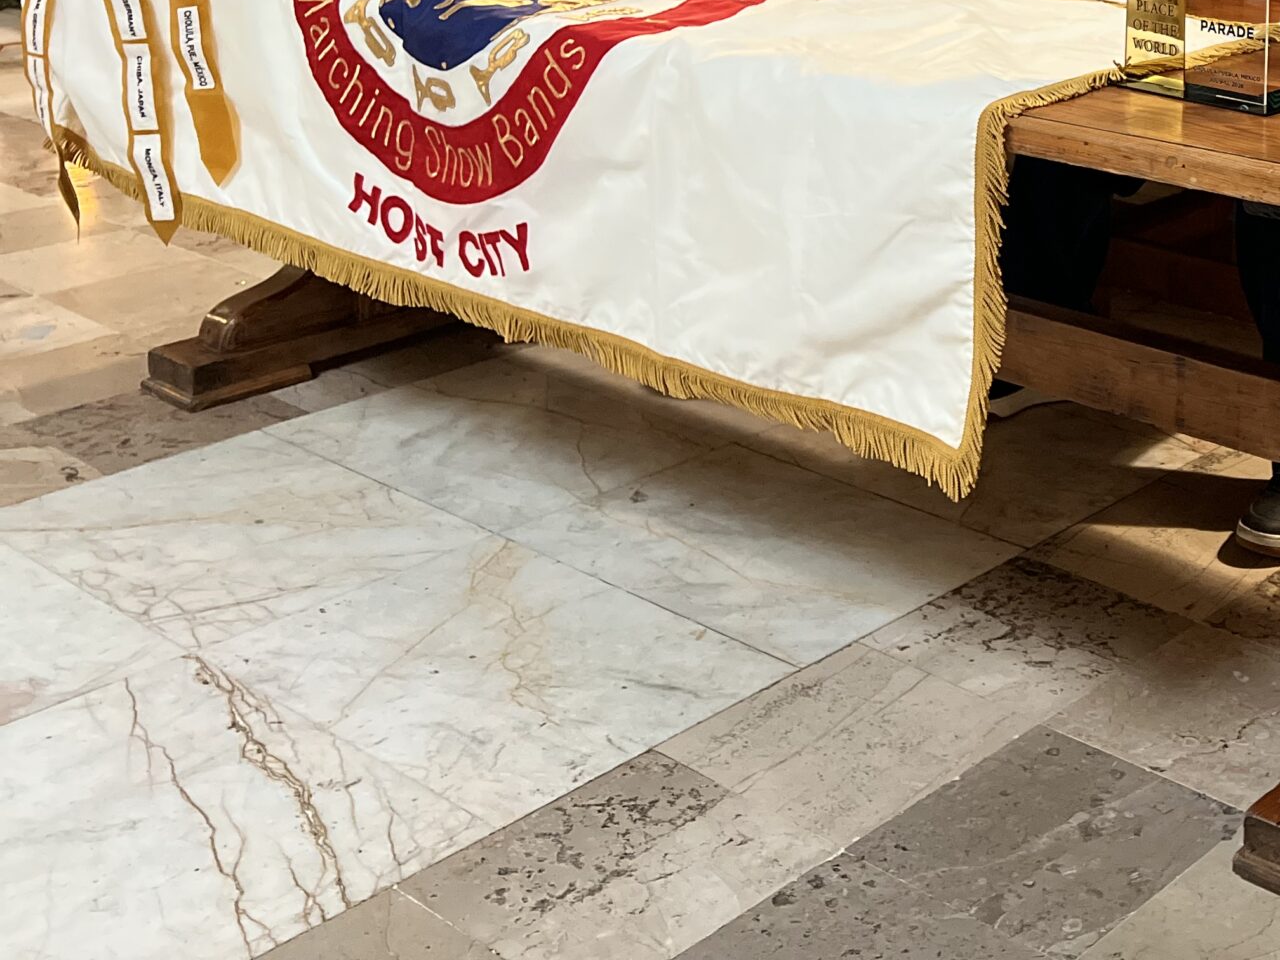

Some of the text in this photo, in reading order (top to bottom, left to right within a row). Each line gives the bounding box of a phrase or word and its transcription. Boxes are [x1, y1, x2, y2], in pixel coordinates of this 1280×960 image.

[1133, 18, 1179, 37] OF THE
[1136, 0, 1175, 17] PLACE
[1132, 37, 1178, 56] WORLD
[1200, 20, 1254, 39] PARADE
[136, 55, 147, 118] CHIBA, JAPAN
[424, 125, 493, 188] Show
[492, 37, 587, 168] Bands
[145, 148, 165, 208] MONZA, ITALY
[347, 172, 530, 278] HOST CITY
